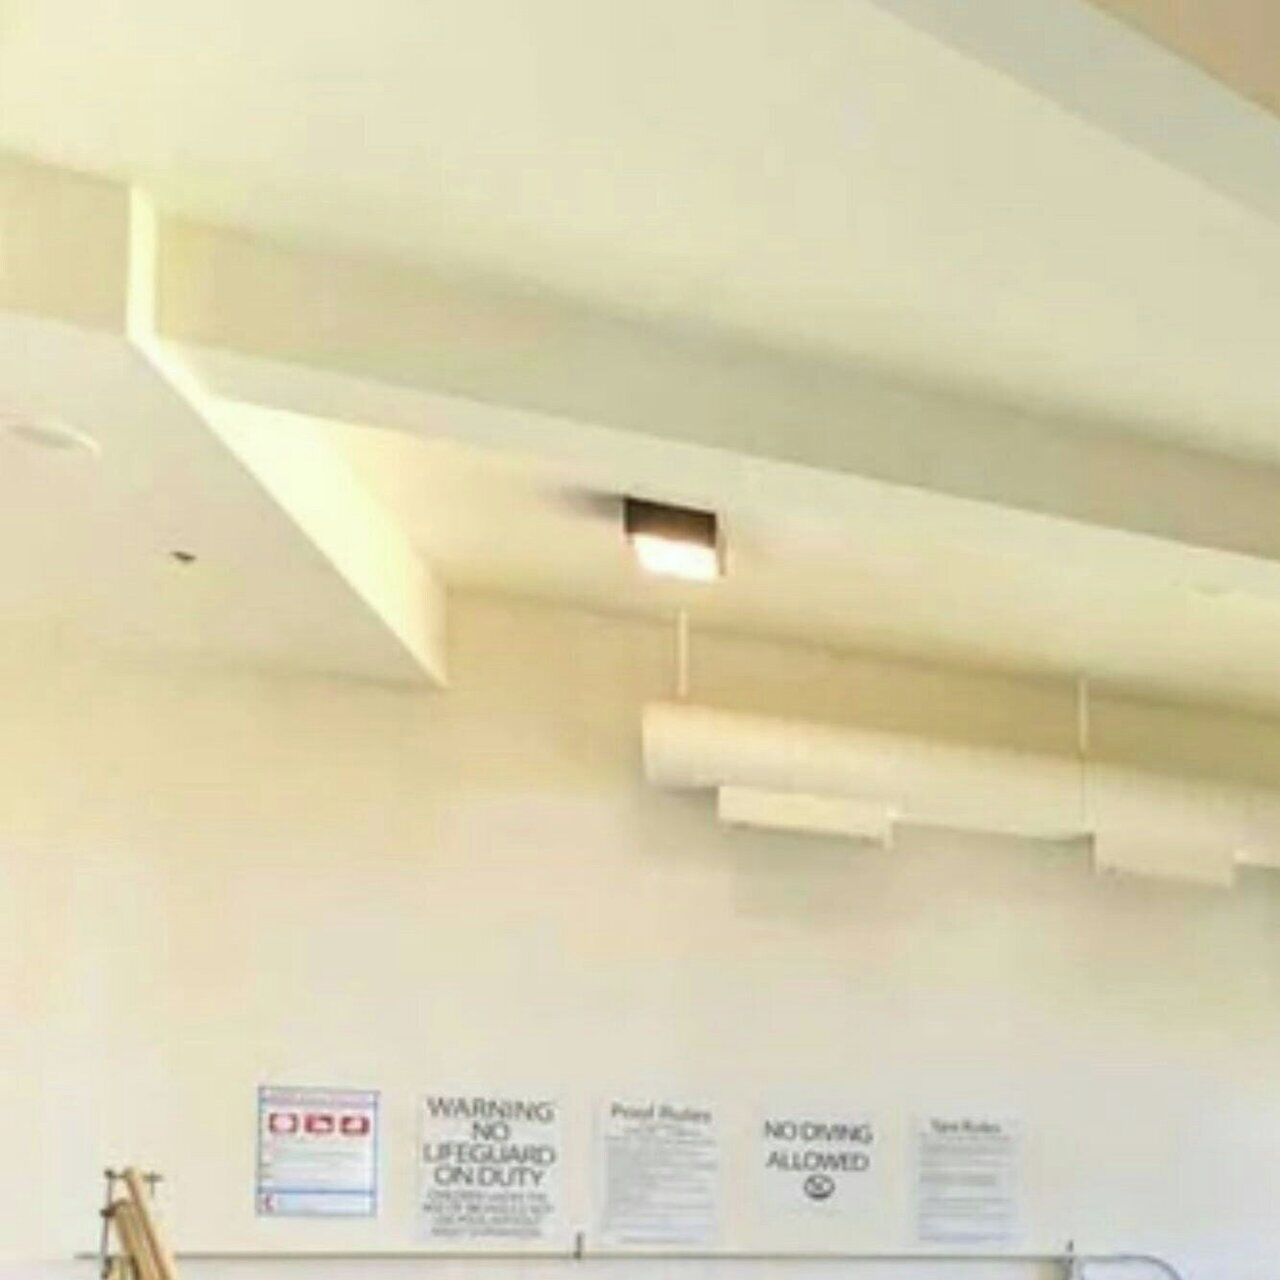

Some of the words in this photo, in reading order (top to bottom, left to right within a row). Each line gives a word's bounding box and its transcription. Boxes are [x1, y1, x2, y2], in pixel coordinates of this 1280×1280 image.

[426, 1097, 555, 1123] WARNING
[611, 1102, 654, 1119] Pool
[658, 1104, 712, 1122] Rules
[472, 1121, 510, 1141] NO
[764, 1119, 797, 1139] NO
[800, 1121, 874, 1143] DIVING
[423, 1142, 556, 1165] LIFEGUARD
[766, 1150, 871, 1172] ALLOWED
[434, 1166, 473, 1186] ON
[478, 1167, 546, 1187] DUTY
